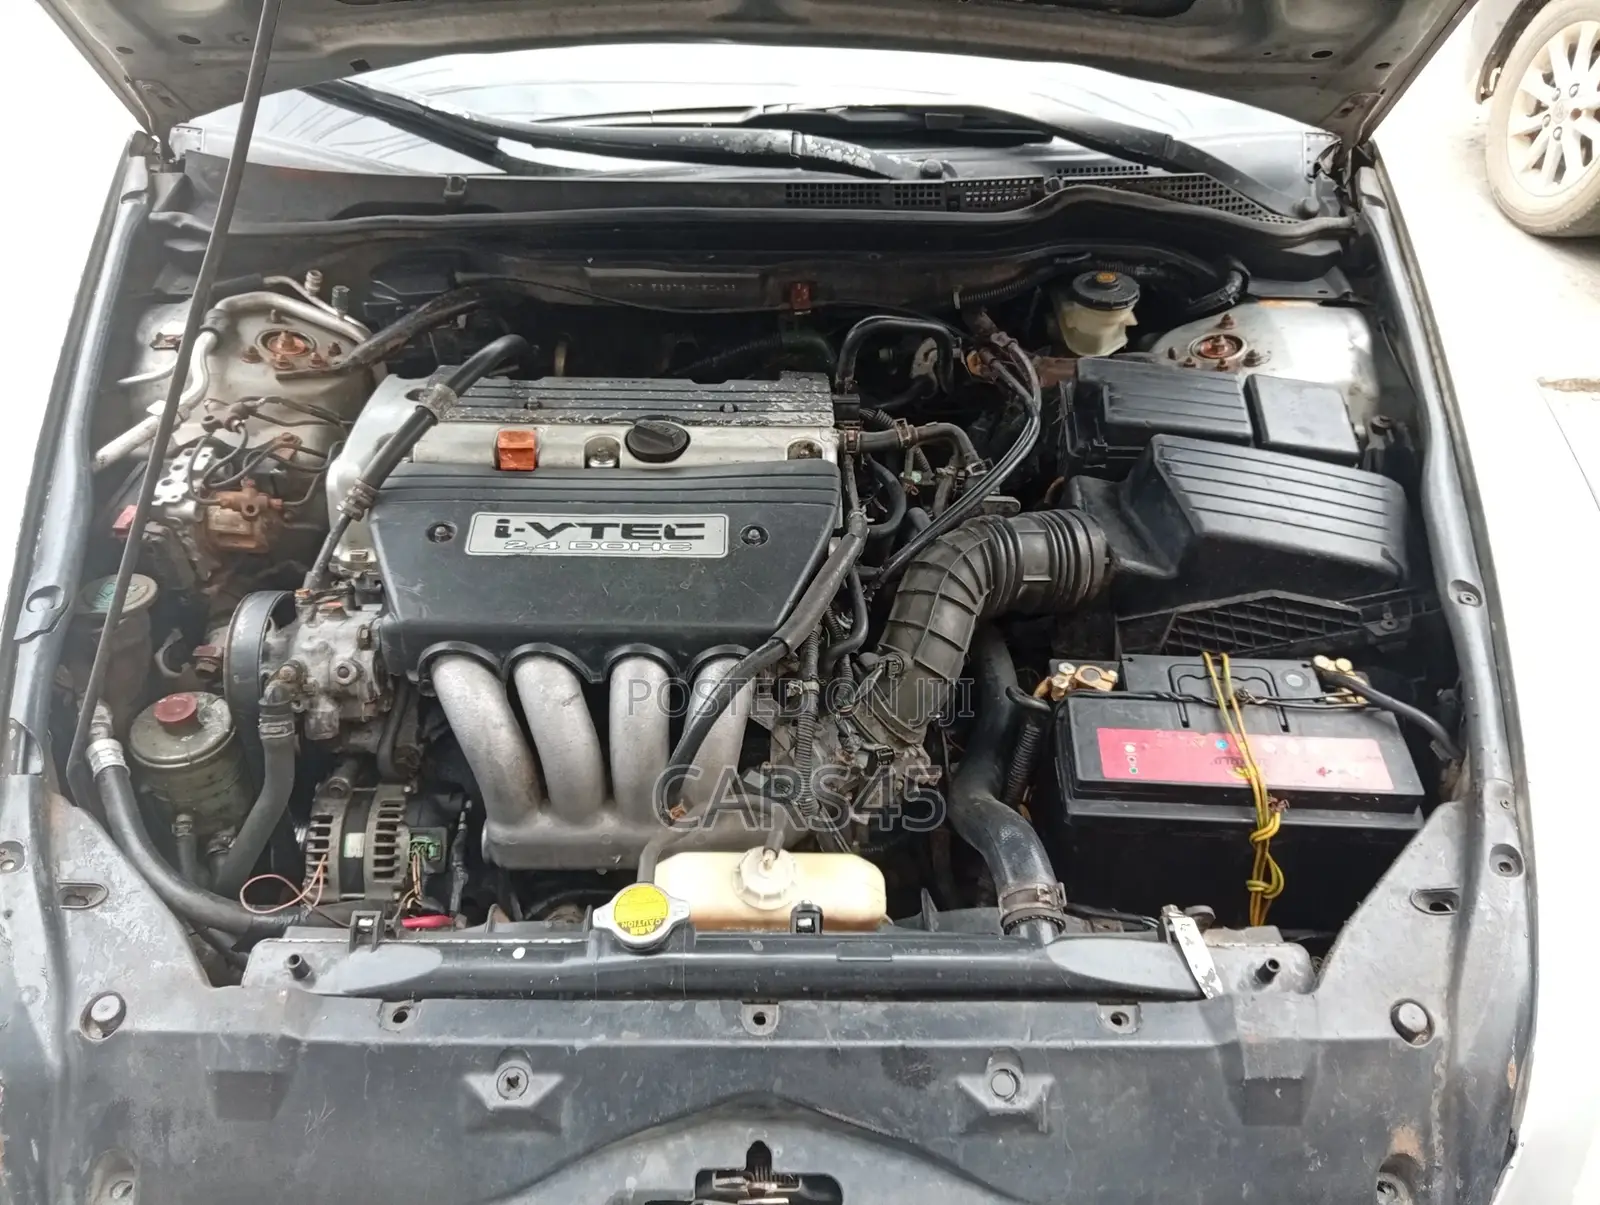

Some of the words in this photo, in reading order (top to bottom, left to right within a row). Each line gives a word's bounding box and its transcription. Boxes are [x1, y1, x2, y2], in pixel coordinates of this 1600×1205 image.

[494, 518, 705, 540] i-VTEC
[503, 540, 560, 551] 2.4
[568, 541, 692, 552] DOHC
[621, 918, 662, 928] CAUTION
